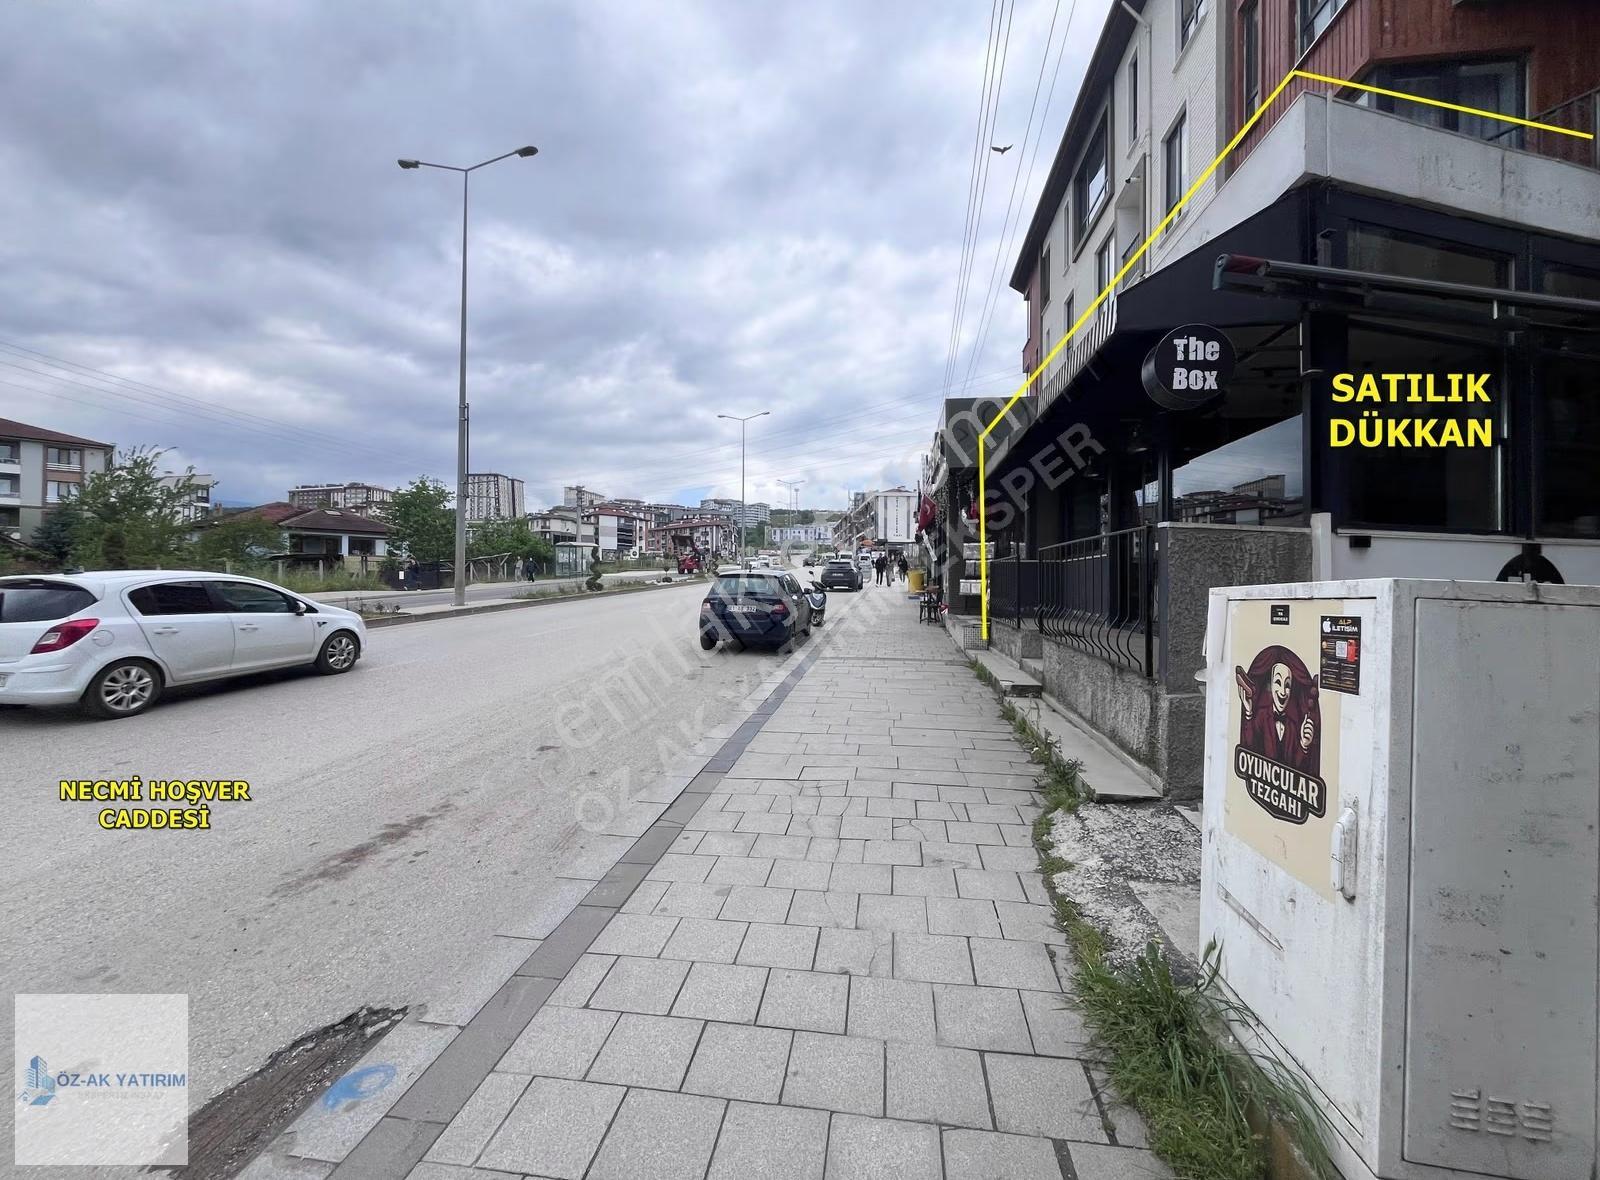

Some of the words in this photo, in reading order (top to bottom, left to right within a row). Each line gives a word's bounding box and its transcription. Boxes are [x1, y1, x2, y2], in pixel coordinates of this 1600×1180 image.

[1173, 336, 1220, 361] The
[1239, 751, 1319, 809] OYUNCULAR
[1250, 778, 1302, 818] TEZGAHI
